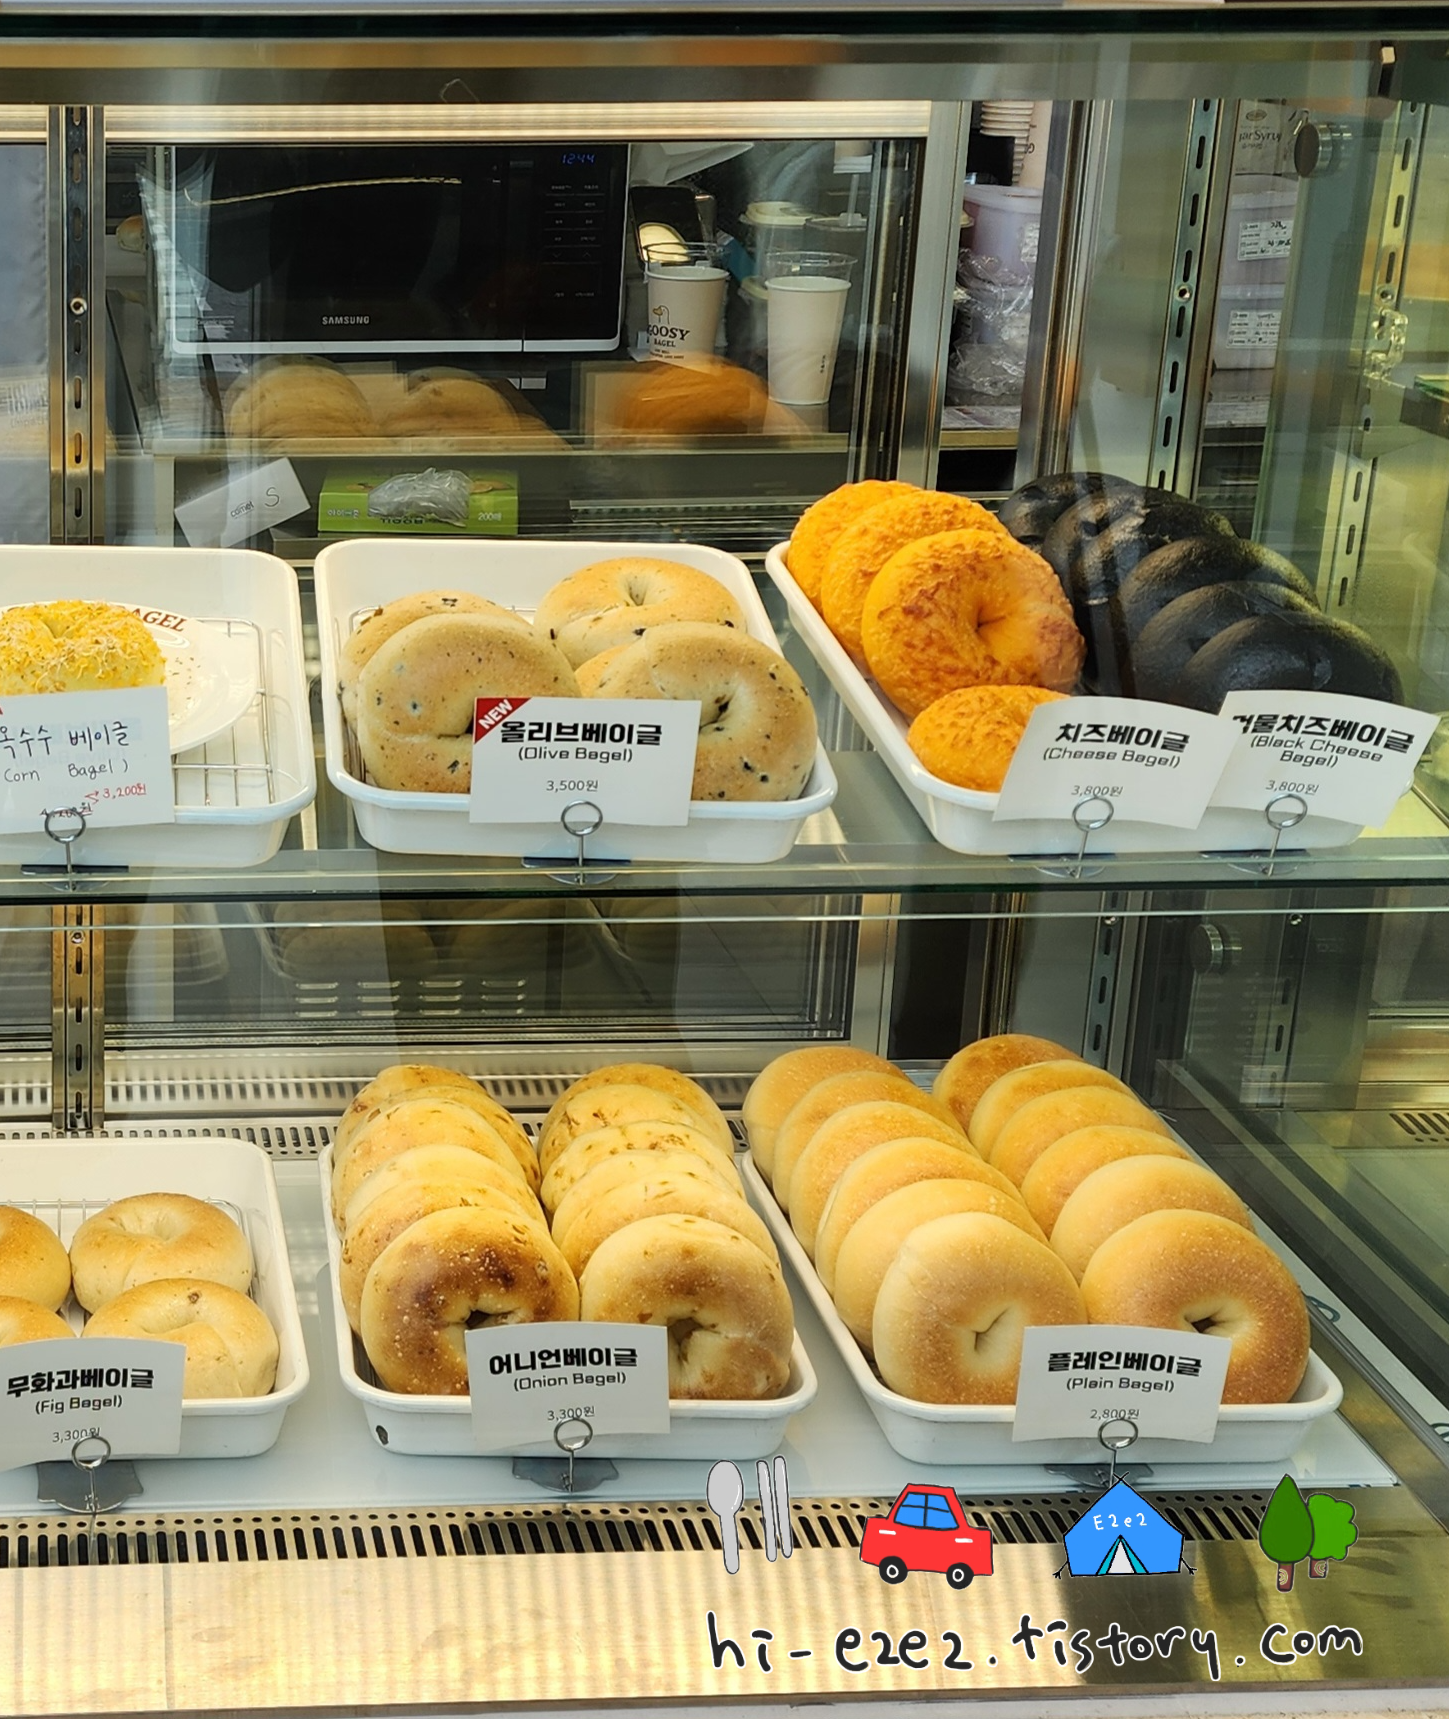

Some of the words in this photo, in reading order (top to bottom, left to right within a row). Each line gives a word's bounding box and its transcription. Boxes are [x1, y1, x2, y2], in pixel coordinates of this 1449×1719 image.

[321, 315, 370, 326] SAMSUNG
[646, 324, 691, 341] GOOSY
[654, 338, 676, 348] BAGEL
[264, 486, 280, 507] S
[230, 500, 255, 518] comet
[478, 698, 514, 730] NEW
[68, 720, 130, 752] 베이글
[501, 721, 662, 746] 올리브베이글
[1055, 722, 1191, 753] 치즈베이글
[518, 747, 570, 761] (Olive
[575, 748, 633, 764] Bagel)
[1043, 746, 1118, 762] (Cheese
[1121, 749, 1181, 769] Bagel)
[1250, 734, 1304, 749] (Black
[1310, 738, 1384, 763] Cheese
[1279, 750, 1339, 768] Bagel)
[545, 780, 599, 793] 3,500원
[1071, 784, 1124, 798] 3,800원
[1265, 779, 1320, 796] 3,800원
[488, 1347, 638, 1375] 어니언베이글
[1047, 1350, 1203, 1377] 플레인베이글
[6, 1367, 154, 1398] 무화과베이글
[513, 1374, 568, 1392] (Onion
[572, 1371, 627, 1387] Bagel)
[1066, 1377, 1114, 1391] (Plain
[1118, 1377, 1175, 1392] Bagel)
[35, 1399, 65, 1415] (Fig
[69, 1394, 123, 1411] Bagel)
[547, 1405, 595, 1421] 3,300원
[1090, 1408, 1140, 1421] 2,800원
